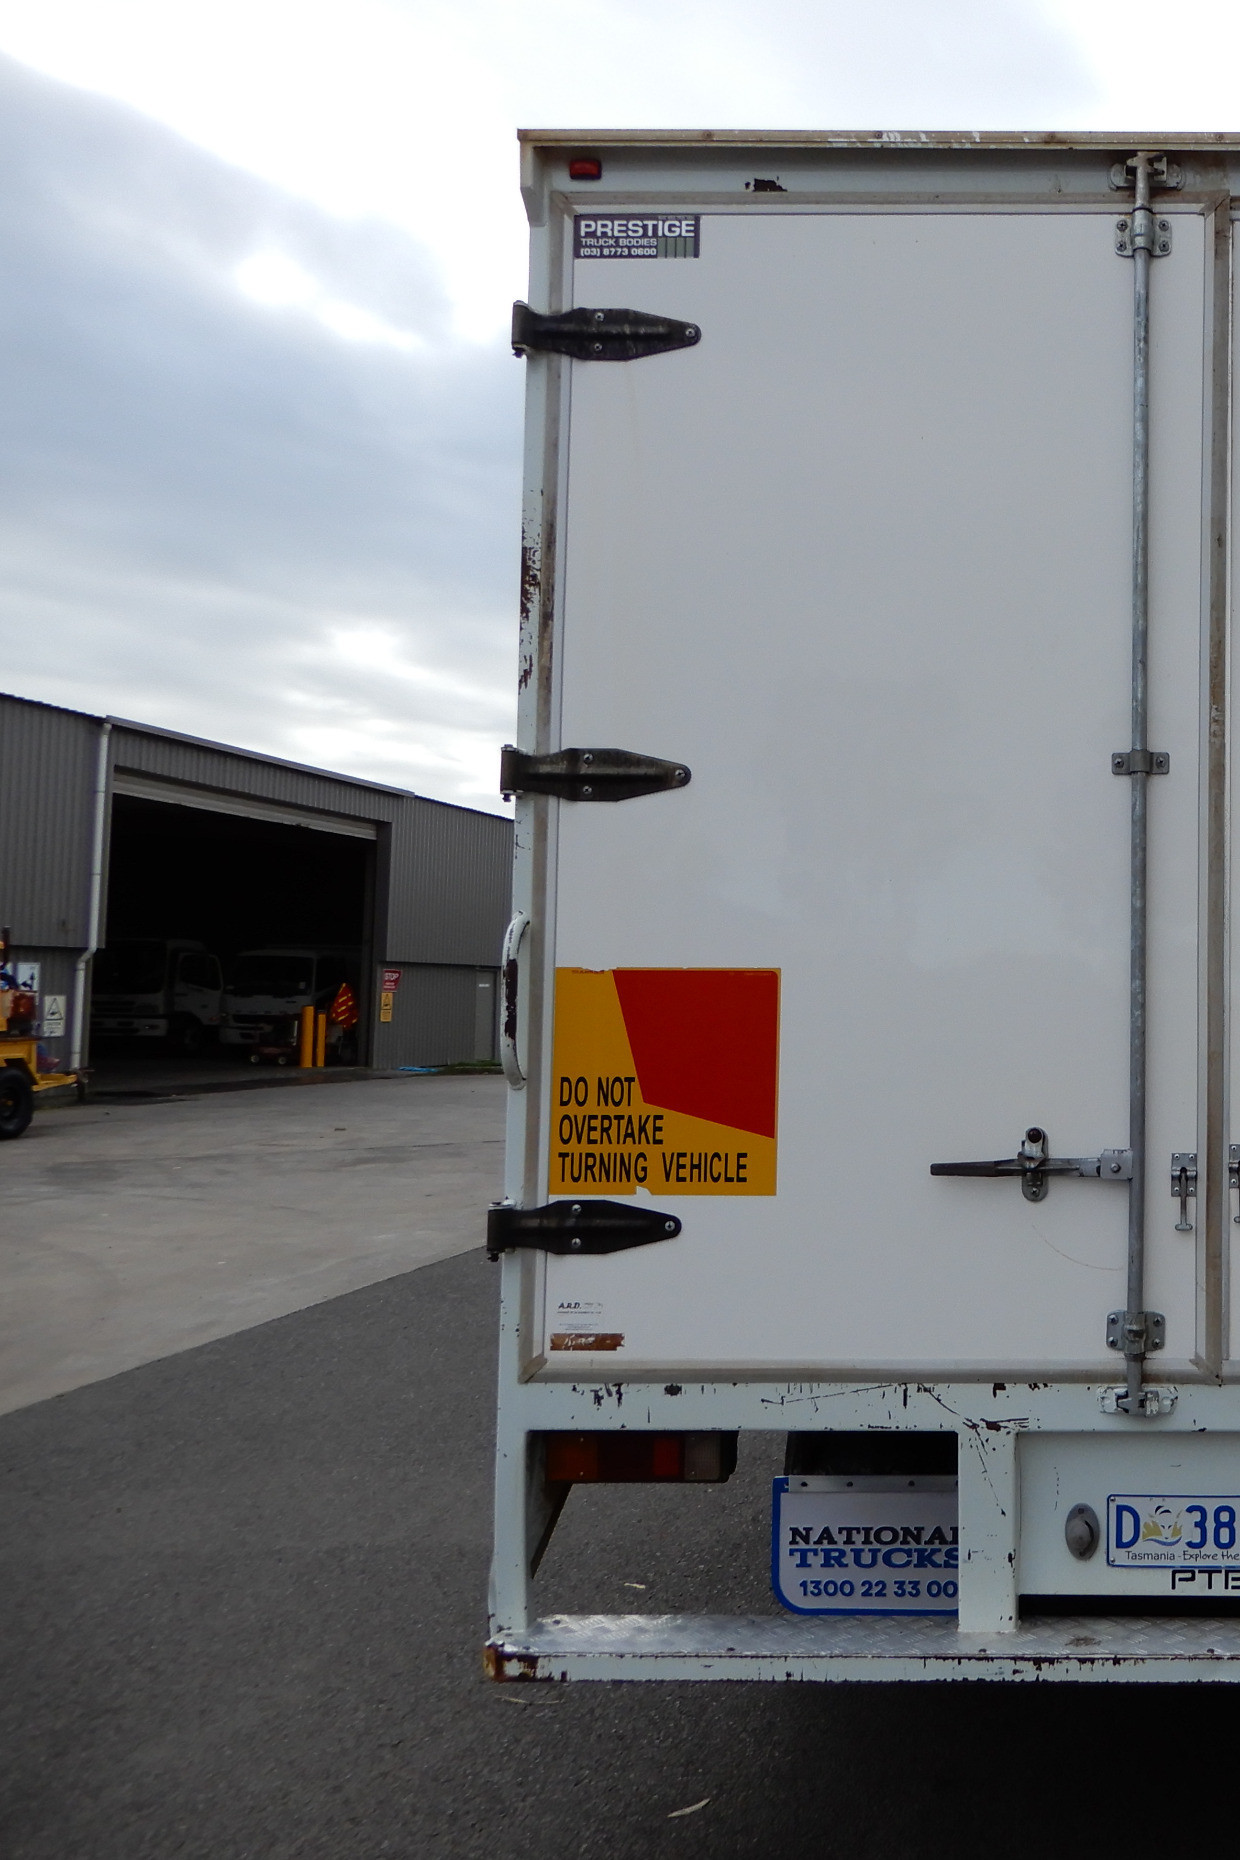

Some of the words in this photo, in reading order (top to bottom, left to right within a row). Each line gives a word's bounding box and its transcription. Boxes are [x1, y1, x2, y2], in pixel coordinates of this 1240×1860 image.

[580, 220, 695, 237] PRESTIGE
[581, 238, 616, 246] TRUCK
[619, 238, 657, 246] BODIES
[580, 248, 600, 257] (03)
[603, 248, 629, 256] 8773
[631, 248, 657, 256] 0600
[559, 1076, 588, 1107] DO
[597, 1076, 635, 1107] NOT
[559, 1114, 664, 1145] OVERTAKE
[558, 1152, 648, 1183] TURNING
[662, 1152, 748, 1183] VEHICLE
[1185, 1505, 1236, 1549] 38
[789, 1548, 958, 1568] TRUCKS
[1125, 1551, 1175, 1561] Tasmania
[1183, 1551, 1218, 1562] Explore
[1221, 1551, 1240, 1561] the
[800, 1580, 855, 1597] 1300
[861, 1580, 887, 1597] 22
[894, 1580, 921, 1598] 33
[926, 1580, 958, 1598] 00
